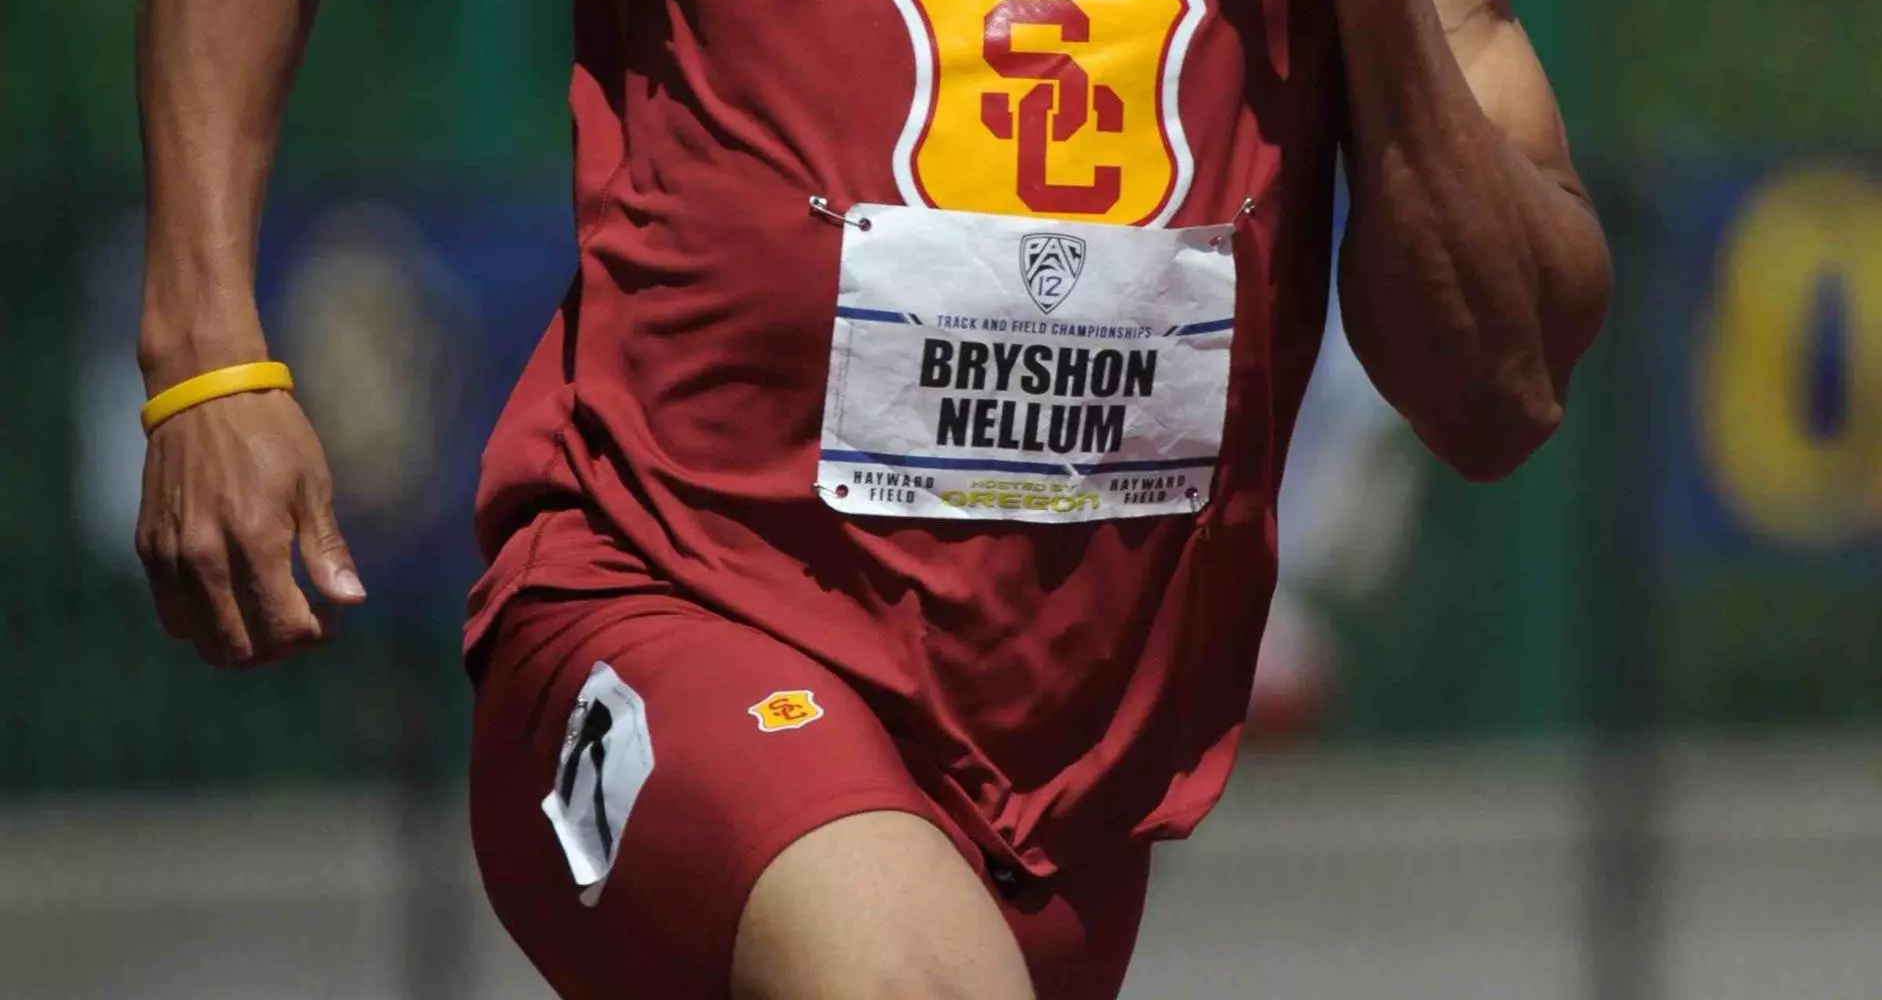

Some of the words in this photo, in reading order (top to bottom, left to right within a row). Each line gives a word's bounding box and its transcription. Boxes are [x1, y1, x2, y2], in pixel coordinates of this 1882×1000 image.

[1038, 275, 1062, 297] 12
[938, 315, 977, 330] TRACK
[982, 319, 1007, 332] AND
[1011, 320, 1047, 335] FIELD
[1051, 323, 1152, 339] CHAMPIONSHIPS
[919, 338, 1158, 398] BRYSHON
[936, 397, 1126, 454] NELLUM
[853, 471, 935, 489] HAYWARD
[970, 479, 1046, 492] HOSTED
[1049, 482, 1077, 492] BY
[1109, 475, 1186, 491] HAYWARD
[870, 488, 915, 504] FIELD
[1123, 489, 1167, 505] FIELD
